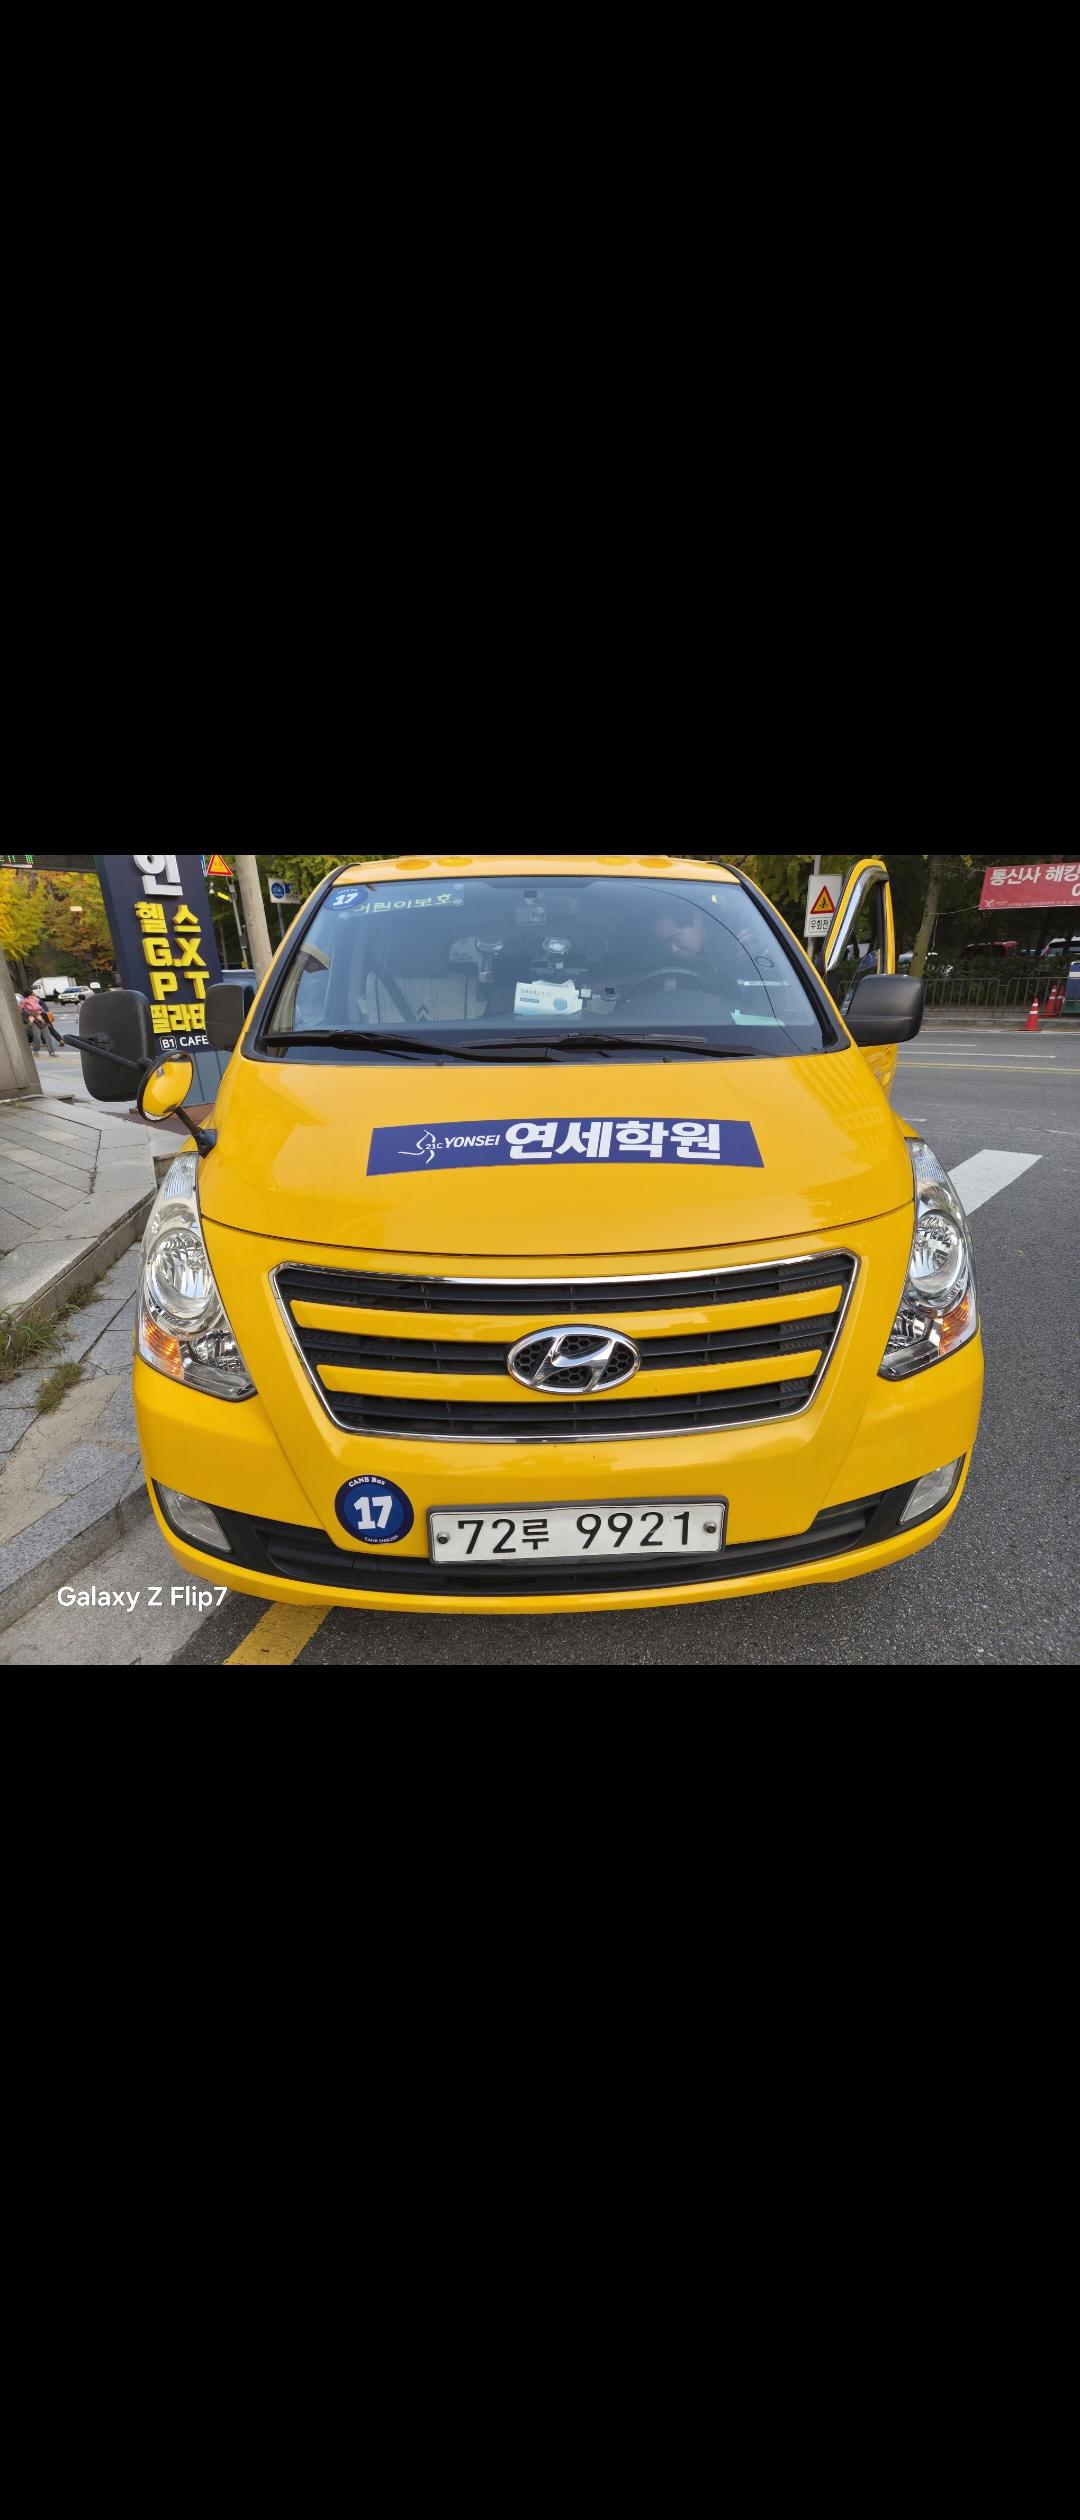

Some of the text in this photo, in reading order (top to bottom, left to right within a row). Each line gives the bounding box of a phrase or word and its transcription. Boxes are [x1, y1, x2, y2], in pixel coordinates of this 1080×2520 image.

[990, 867, 1042, 886] 통신사
[332, 892, 359, 906] 17
[354, 893, 452, 914] 어린이보호
[134, 901, 202, 934] 헬스
[162, 1035, 209, 1049] B1 CAFE
[444, 1134, 501, 1149] YONSEI
[505, 1120, 721, 1160] 연세학원
[353, 1495, 393, 1530] 17
[457, 1510, 690, 1555] 72루 9921
